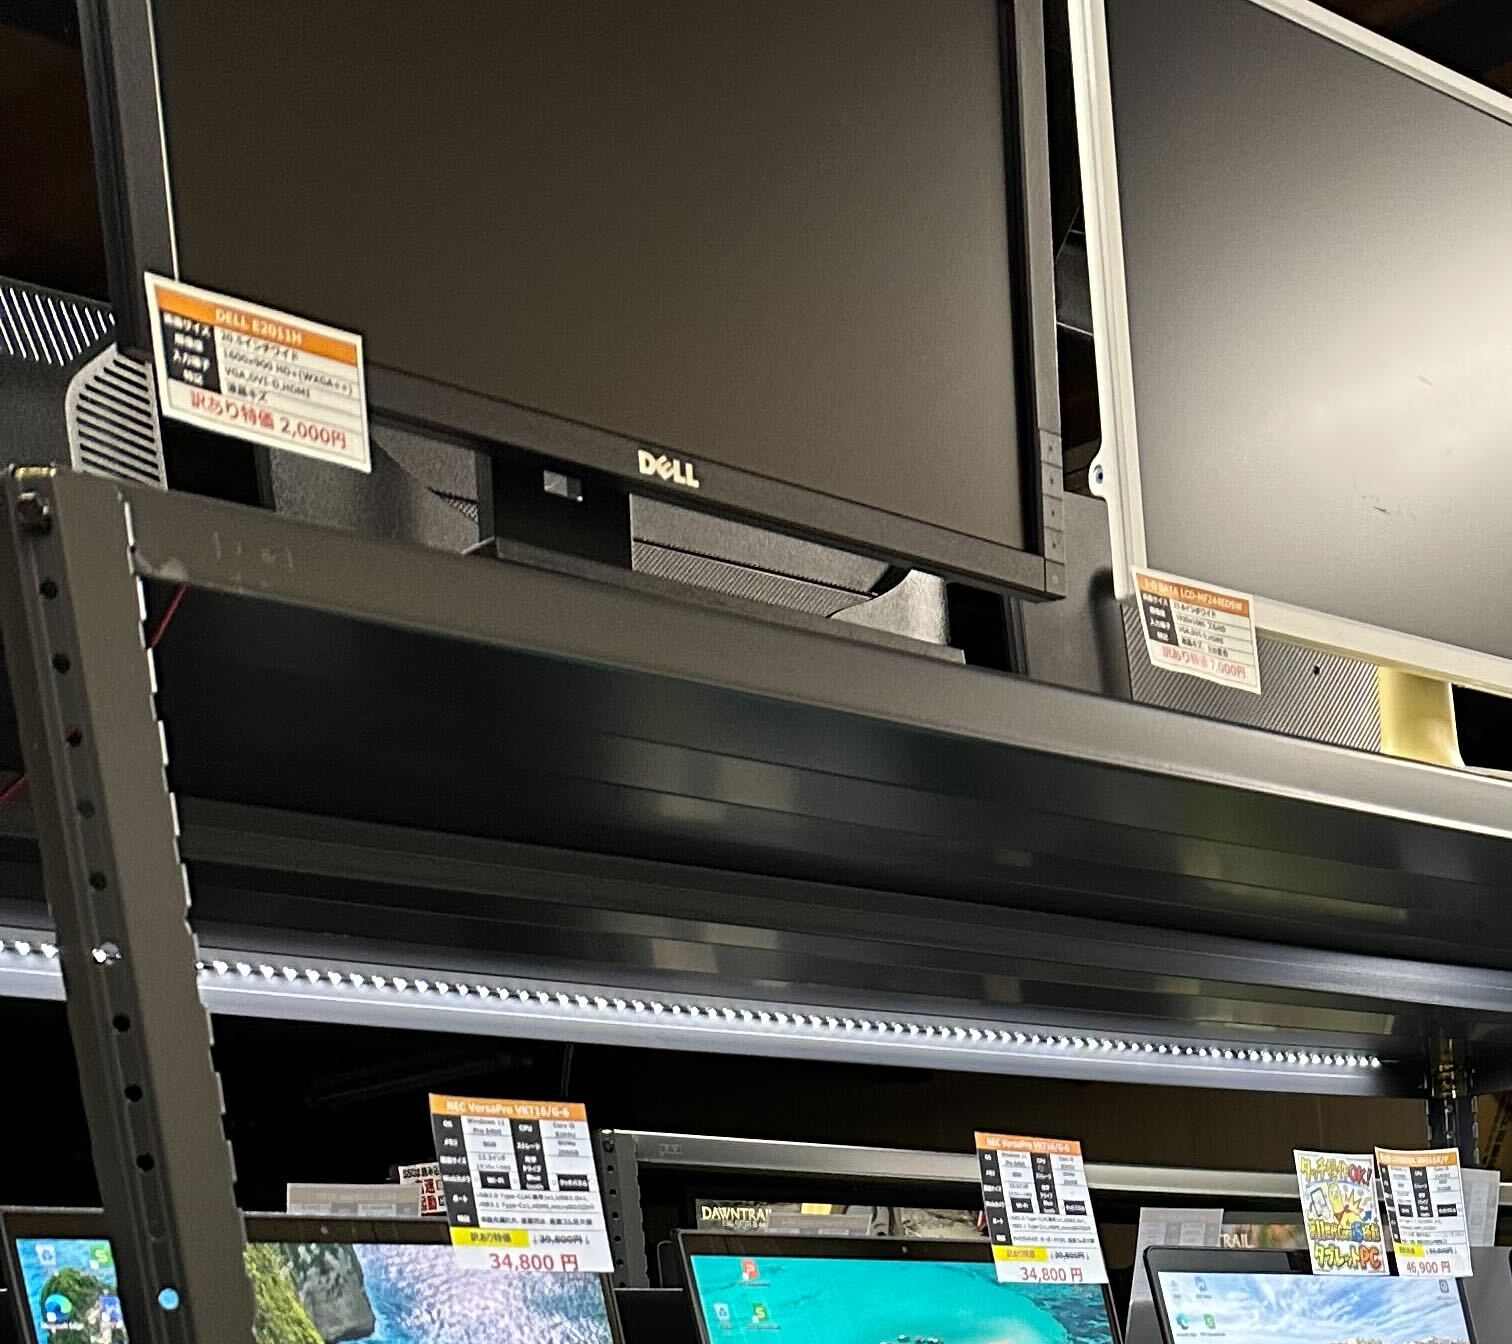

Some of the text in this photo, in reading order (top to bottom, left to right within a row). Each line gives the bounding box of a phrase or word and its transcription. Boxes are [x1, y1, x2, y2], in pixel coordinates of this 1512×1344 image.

[215, 307, 248, 330] DELL
[637, 449, 700, 489] DELL
[488, 1253, 579, 1272] 34,800 円
[1019, 1266, 1084, 1283] 34,800 円
